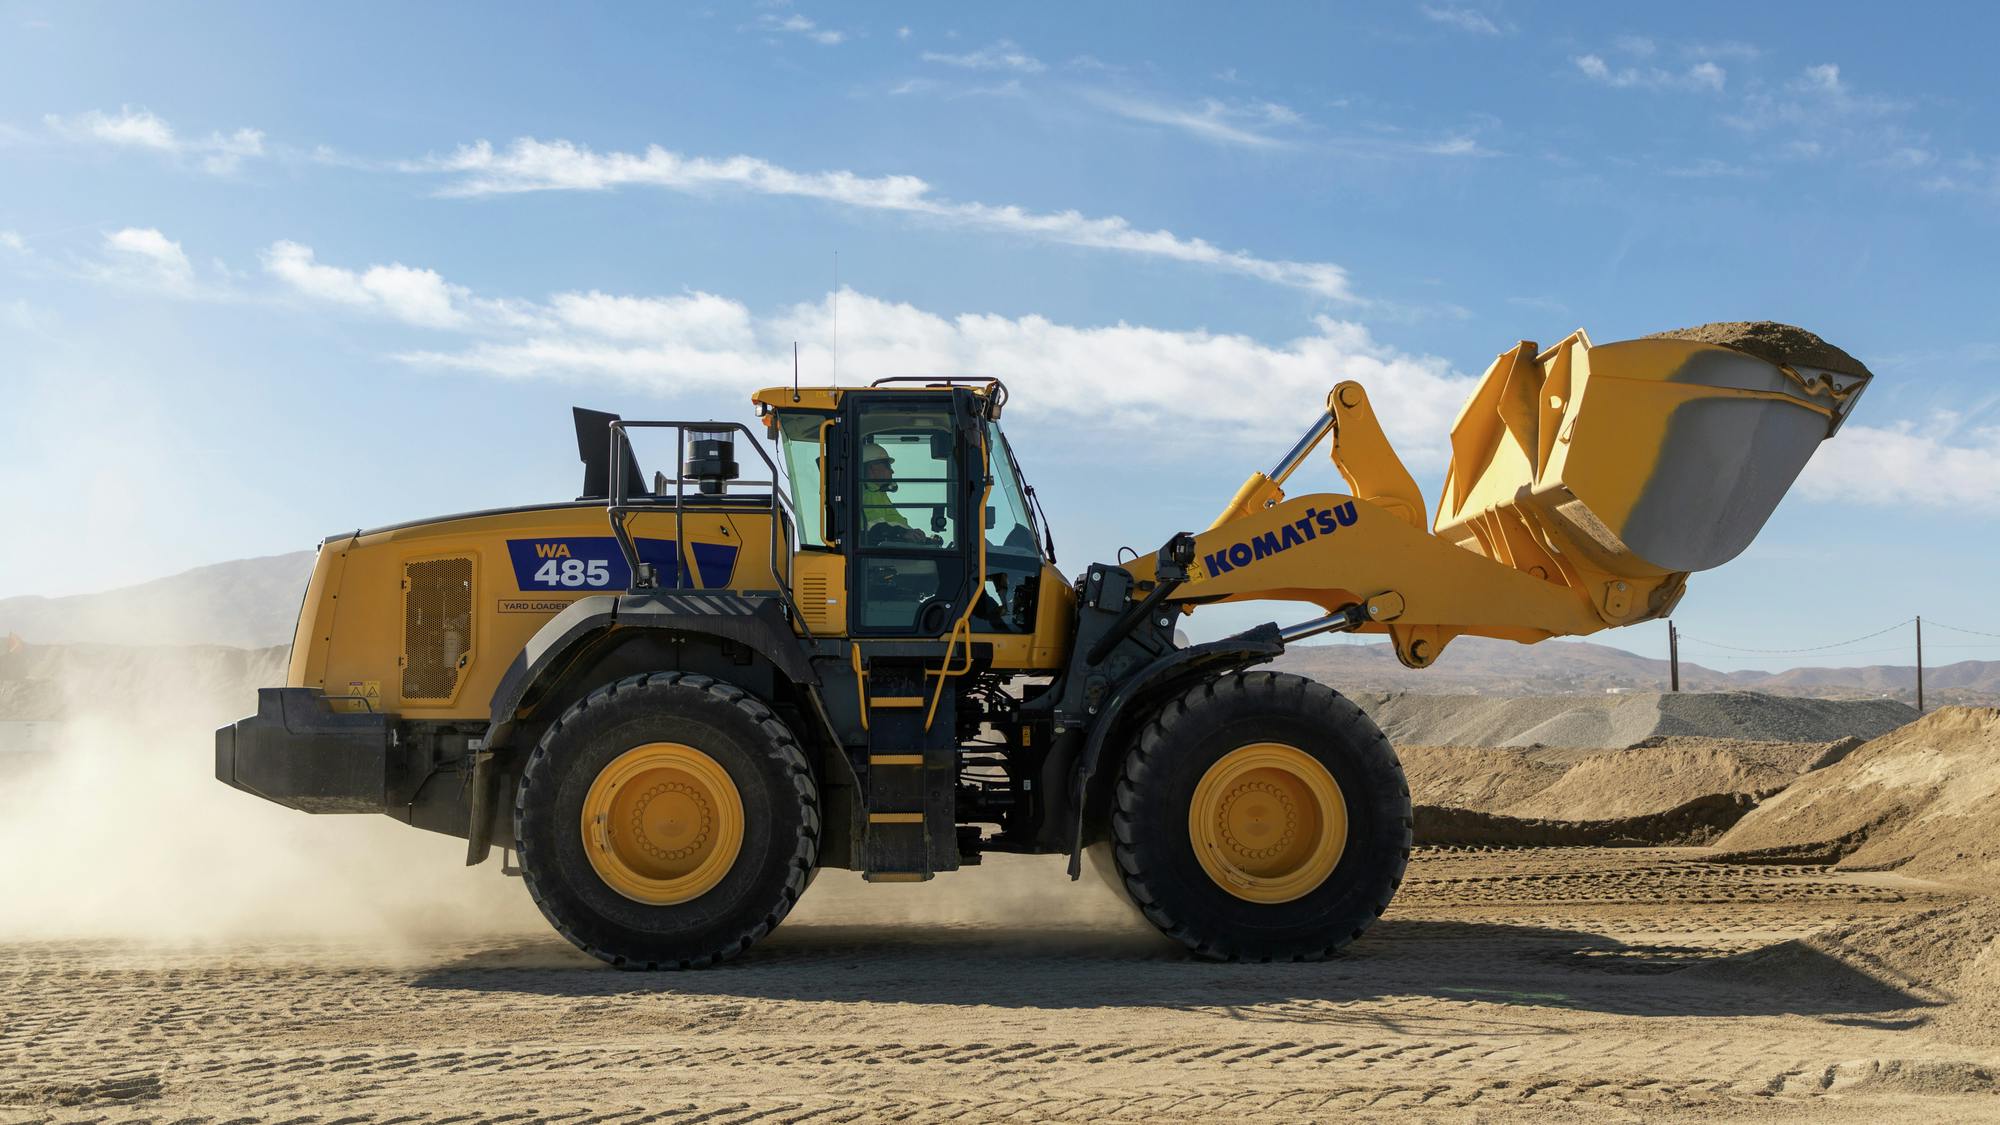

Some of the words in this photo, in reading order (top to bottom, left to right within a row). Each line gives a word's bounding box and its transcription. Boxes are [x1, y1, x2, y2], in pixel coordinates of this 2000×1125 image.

[1204, 501, 1358, 578] KOMATSU
[535, 544, 571, 558] WA
[534, 559, 610, 587] 485
[503, 602, 529, 610] YARD
[531, 602, 568, 610] LOADER
